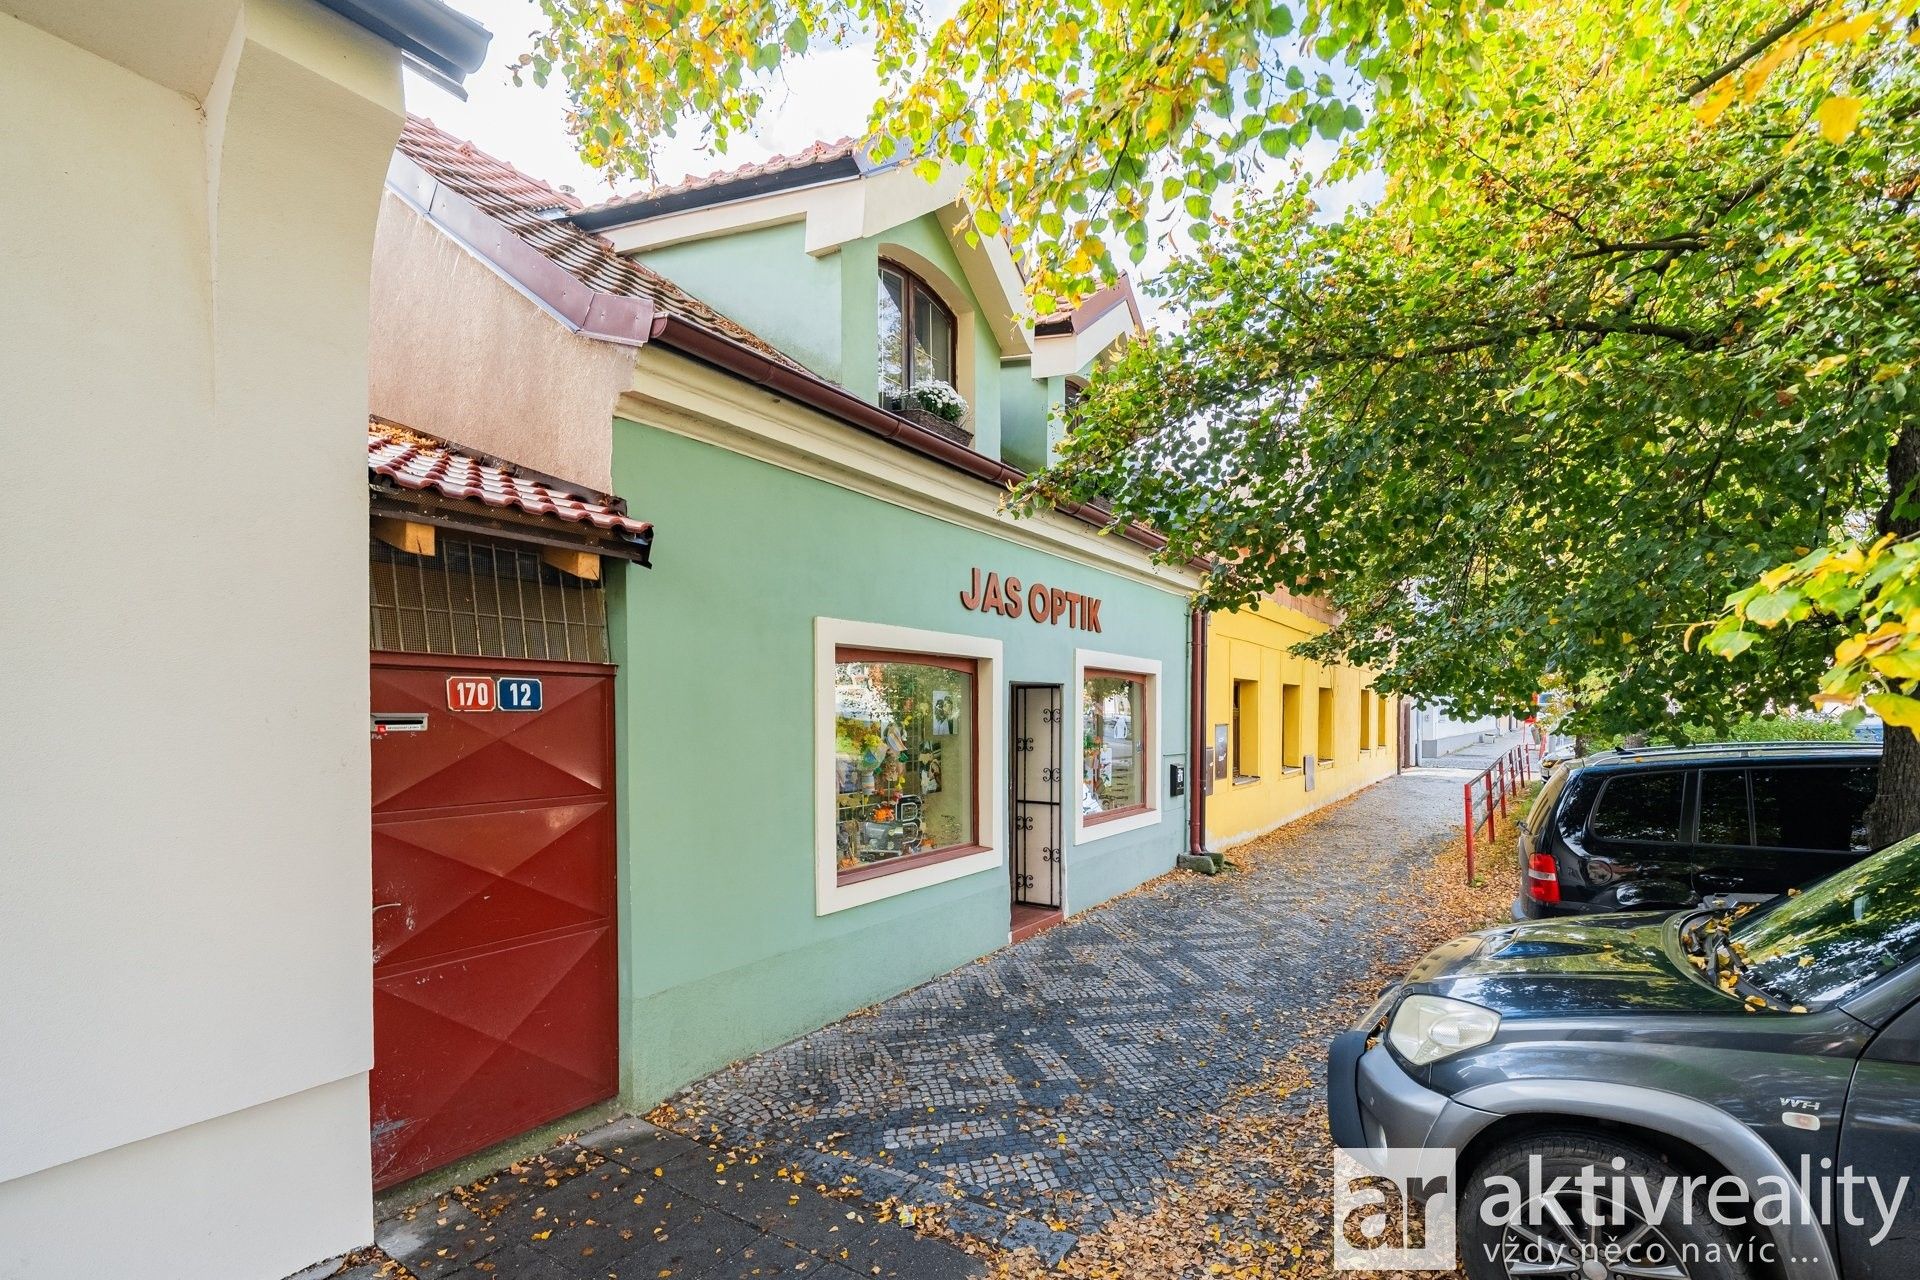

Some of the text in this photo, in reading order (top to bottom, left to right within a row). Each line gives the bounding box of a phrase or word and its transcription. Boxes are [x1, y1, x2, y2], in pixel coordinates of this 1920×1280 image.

[960, 567, 1102, 633] JAS OPTIK
[456, 682, 489, 706] 170
[510, 683, 532, 706] 12
